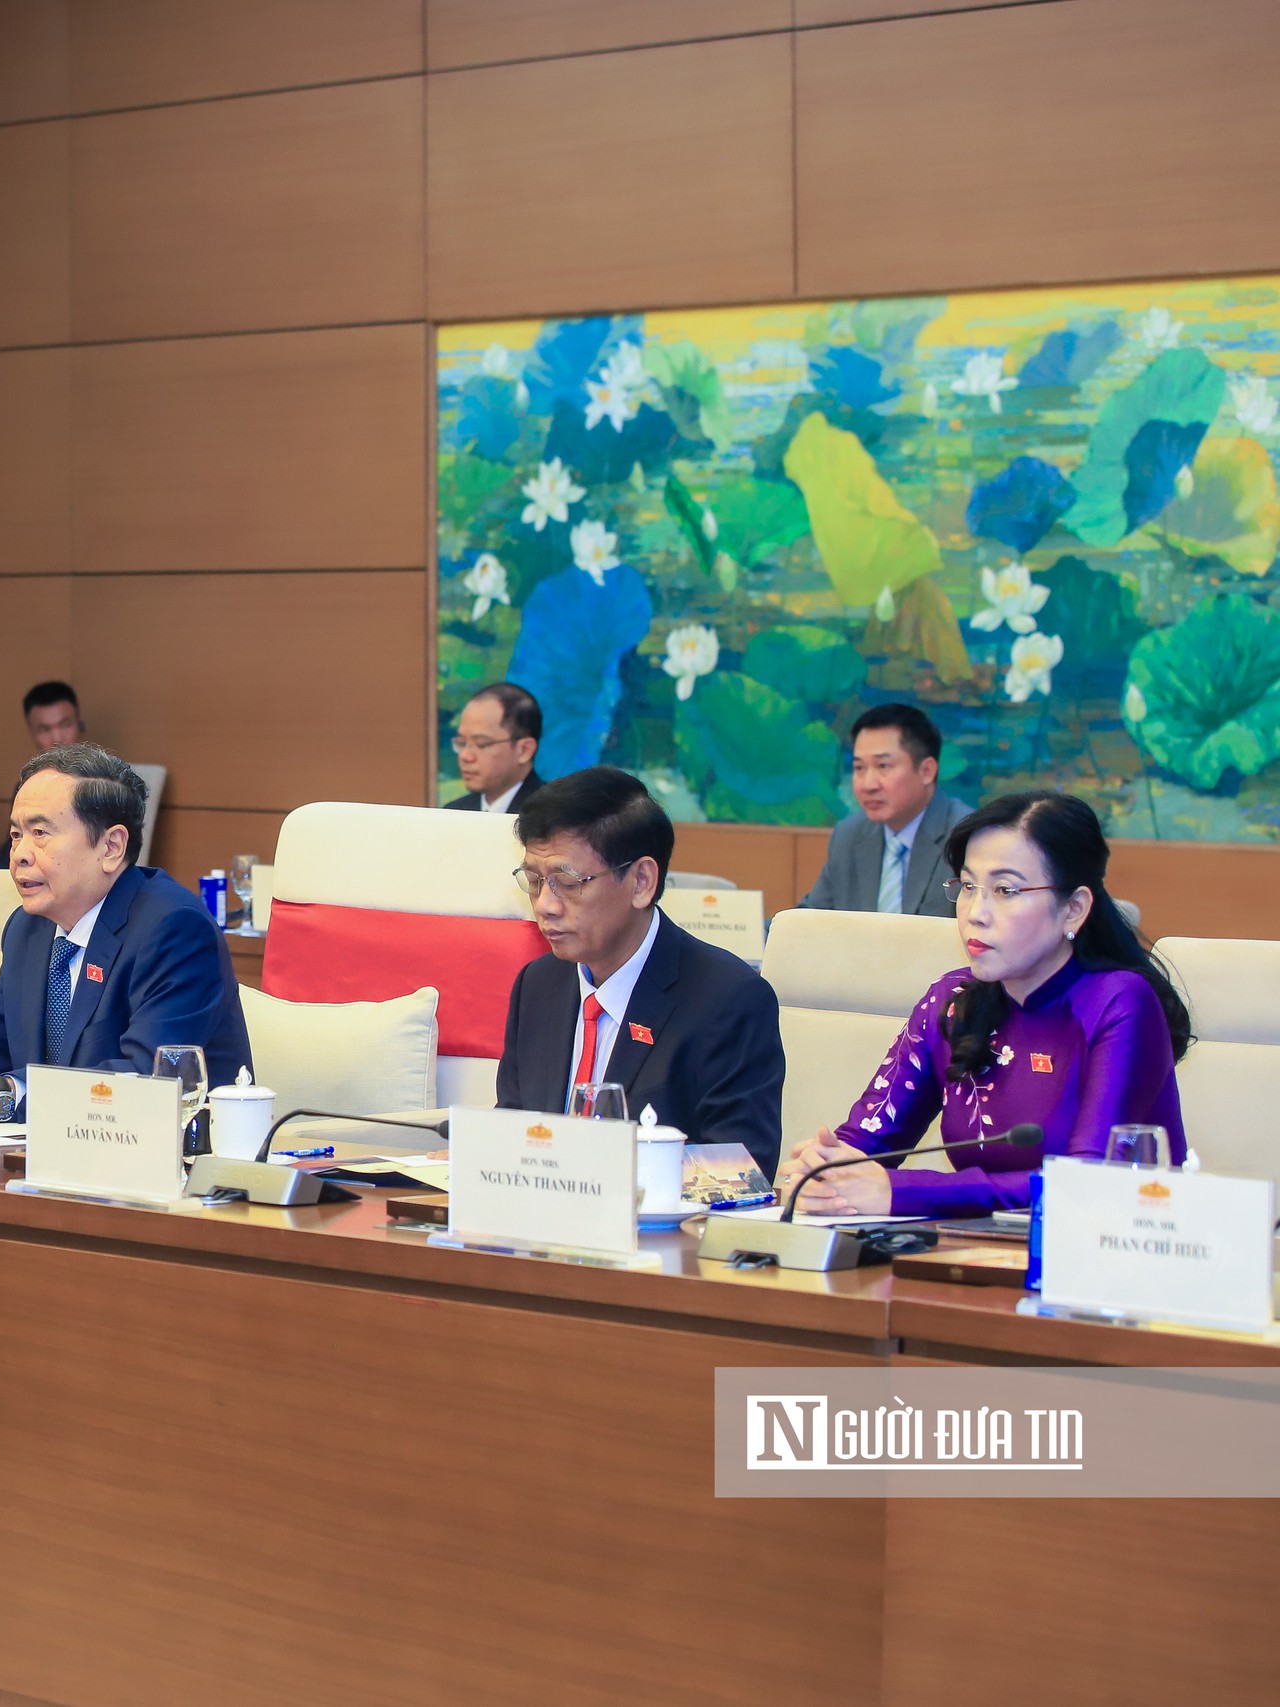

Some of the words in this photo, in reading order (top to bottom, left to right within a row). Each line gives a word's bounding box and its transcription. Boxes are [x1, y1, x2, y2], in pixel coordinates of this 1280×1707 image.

[87, 1112, 104, 1121] HON.
[105, 1114, 117, 1123] MR.
[67, 1124, 89, 1140] LÂM
[91, 1128, 112, 1142] VĂN
[521, 1157, 539, 1166] HON.
[534, 1176, 576, 1192] THANH
[1100, 1234, 1139, 1250] PHAN
